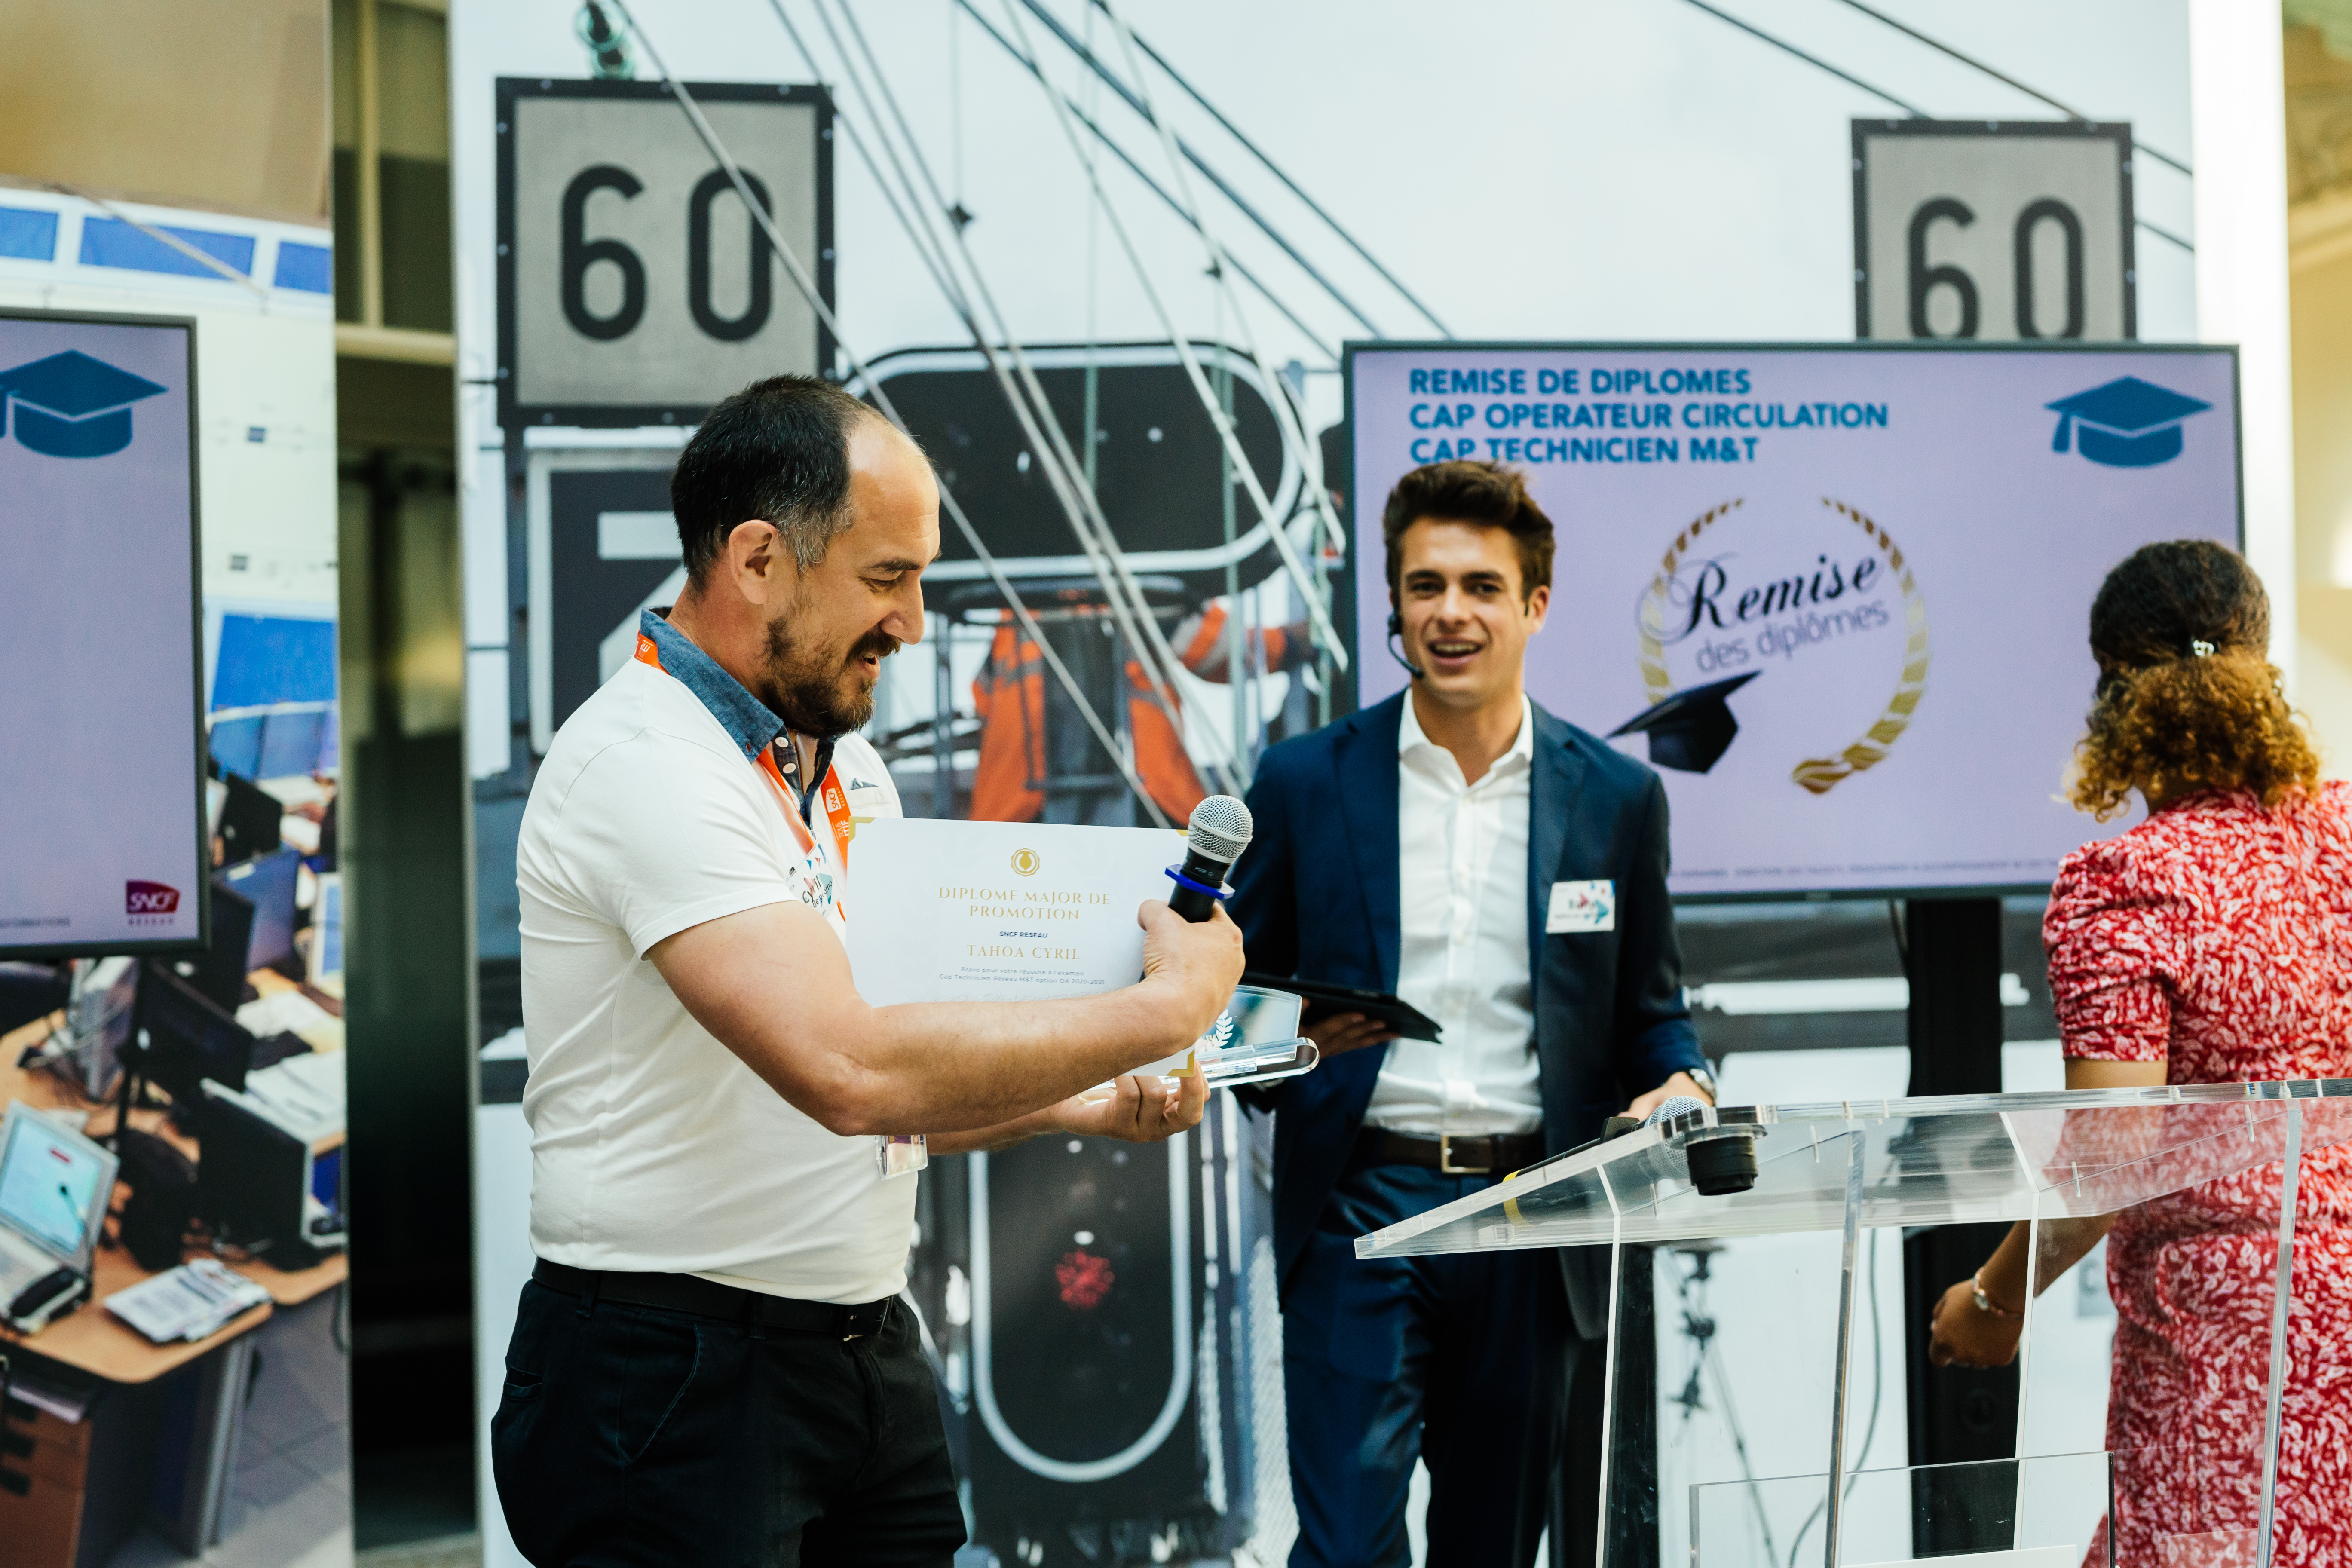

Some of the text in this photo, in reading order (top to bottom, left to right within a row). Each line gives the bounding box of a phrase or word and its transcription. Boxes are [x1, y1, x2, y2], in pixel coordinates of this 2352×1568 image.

[561, 163, 774, 343] 60
[1908, 196, 2084, 338] 60
[1409, 368, 1751, 395] REMISE DE DIPLOMES
[1409, 402, 1888, 429] CAP OPERATEUR CIRCULATION
[1409, 436, 1759, 464] CAP TECHNICIEN M&T
[1637, 553, 1881, 645] Remise
[1695, 600, 1889, 673] des diplômes
[828, 790, 839, 809] SNCF
[835, 822, 845, 838] TOUS
[802, 875, 821, 904] Cyril
[819, 880, 833, 903] promo
[939, 887, 1110, 906] DIPLOME MAJOR DE
[970, 905, 1079, 920] PROMOTION
[967, 945, 1080, 959] TAHOA CYRIL
